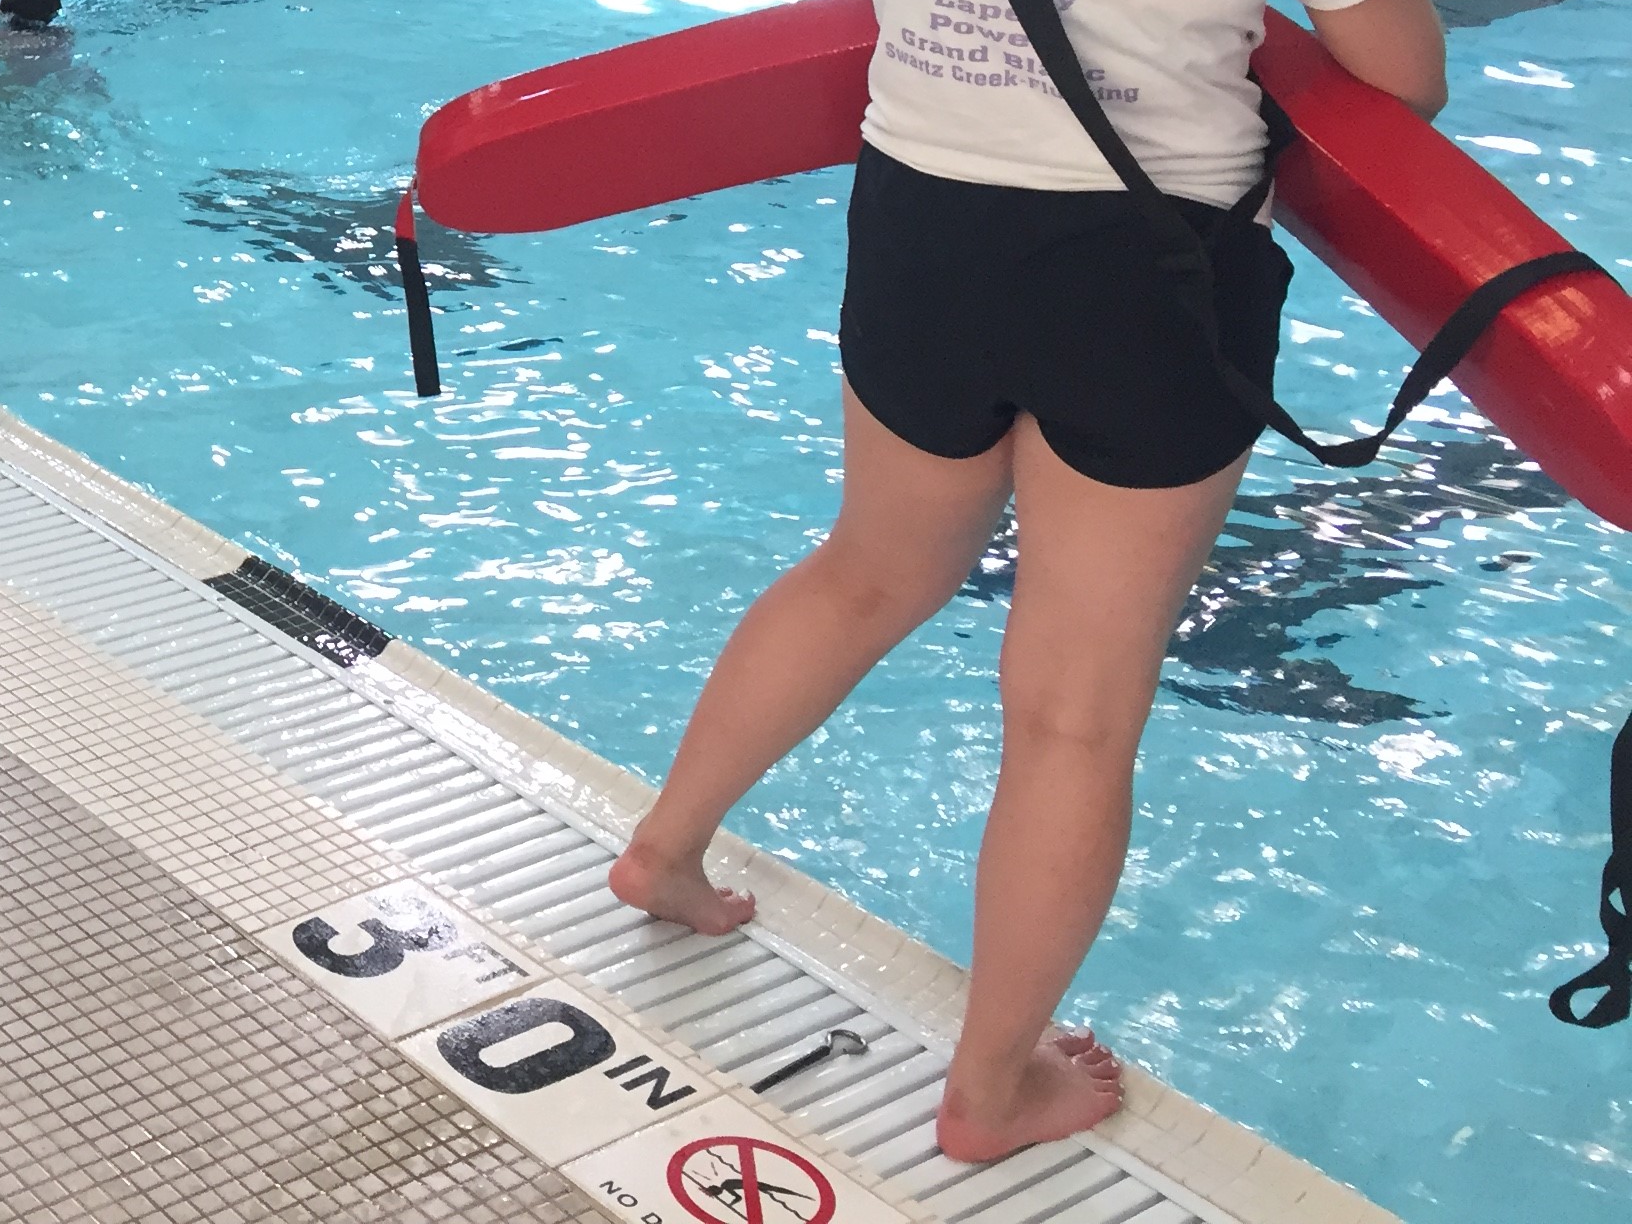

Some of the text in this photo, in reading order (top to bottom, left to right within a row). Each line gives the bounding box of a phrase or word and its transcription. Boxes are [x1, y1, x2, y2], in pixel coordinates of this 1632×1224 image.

[885, 42, 944, 77] Swartz
[902, 28, 989, 62] Grand
[292, 880, 531, 984] 3 FT
[436, 996, 699, 1111] 0 IN
[599, 1180, 639, 1208] NO
